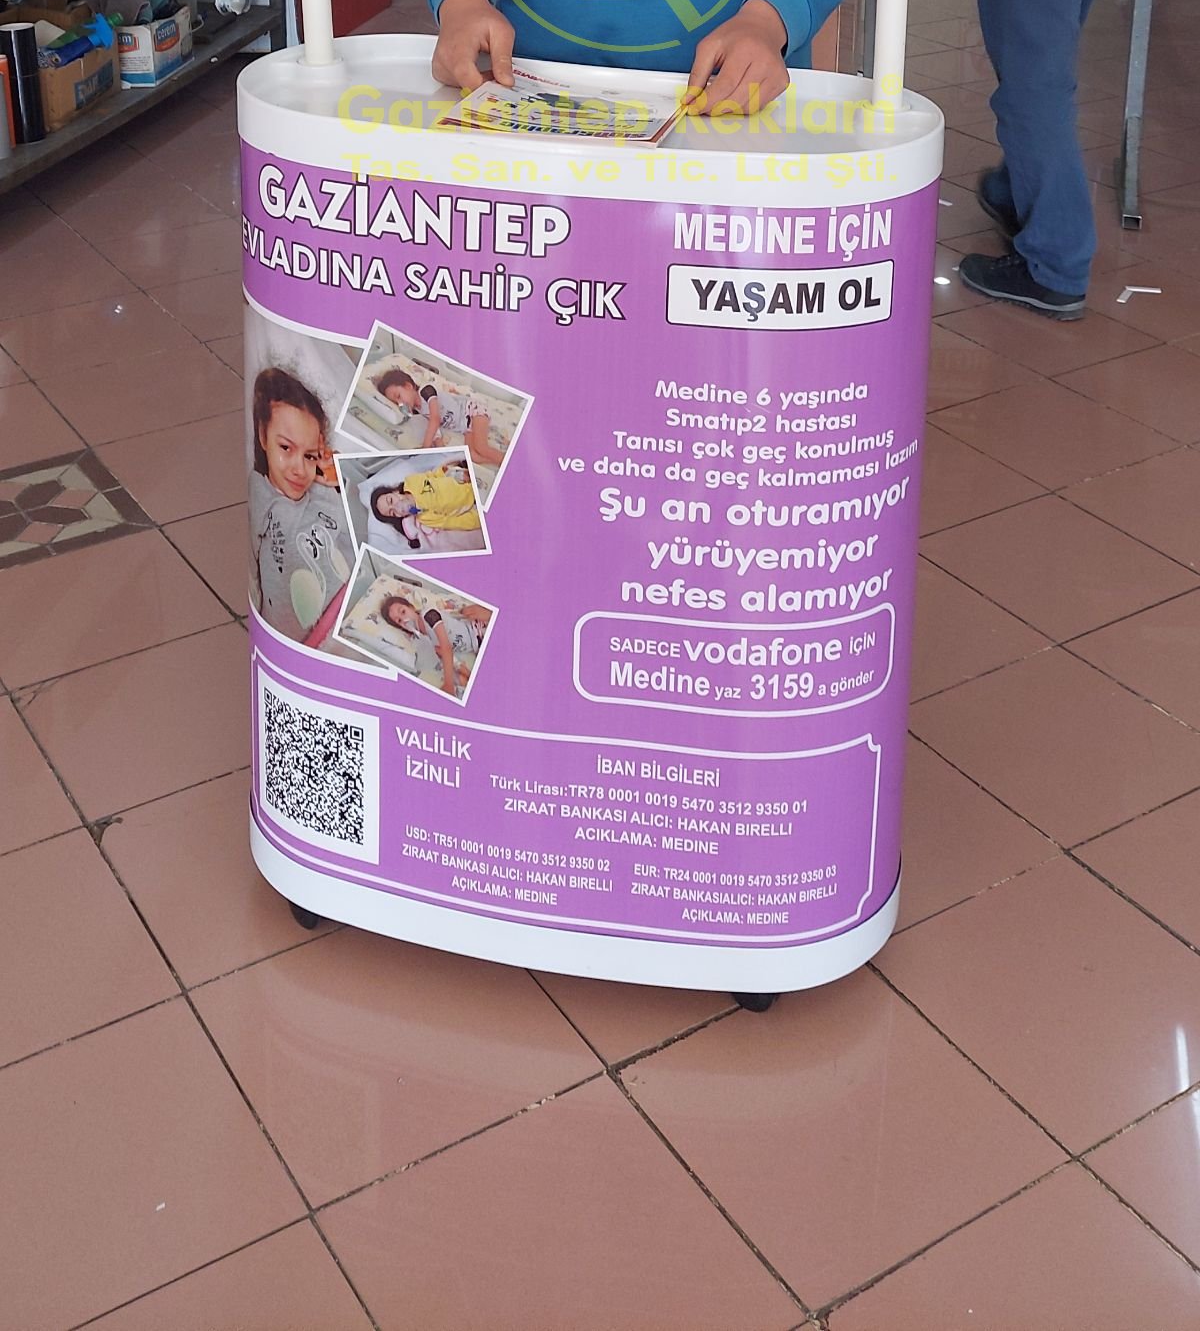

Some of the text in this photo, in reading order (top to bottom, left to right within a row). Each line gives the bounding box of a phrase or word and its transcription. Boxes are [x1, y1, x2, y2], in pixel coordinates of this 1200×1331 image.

[258, 163, 571, 258] GAZİANTEP
[674, 204, 893, 262] MEDİNE İÇİN
[242, 215, 626, 326] EVLADINA SAHİP ÇIK
[691, 277, 881, 322] YAŞAM OL
[655, 380, 868, 410] Medine 6 yaşında
[666, 408, 857, 436] Smatıp2 hastası
[558, 438, 919, 489] ve daha da geç kalmaması lazım
[612, 428, 896, 465] Tanısı çok geç konulmuş
[599, 476, 911, 527] Şu an oturamıyor
[647, 534, 879, 576] yürüyemiyor
[621, 568, 893, 613] nefes alamıyor
[609, 631, 876, 667] SADECE vodafone İÇİN
[610, 660, 875, 701] Medine yaz 3159 a gönder
[396, 726, 472, 761] VALİLİK
[406, 755, 461, 789] İZİNLİ
[597, 754, 721, 788] İBAN BİLGİLERİ
[490, 774, 521, 791] Türk
[608, 788, 640, 803] 0001
[645, 791, 678, 808] 0019
[682, 796, 715, 813] 5470
[719, 800, 752, 816] 3512
[756, 801, 789, 816] 9350
[792, 799, 808, 814] 01
[504, 797, 793, 837] ZIRAAT BANKASI ALICI: HAKAN BIRELLI
[405, 824, 610, 872] USD: TR51 0001 0019 5470 3512 9350 02
[574, 827, 720, 855] ACIKLAMA: MEDINE
[402, 843, 613, 893] ZIRAAT BANKASI ALICI: HAKAN BIRELLI
[634, 863, 837, 887] EUR: TR24 0001 0019 5470 3512 9350 03
[451, 876, 558, 906] AÇIKLAMA: MEDINE
[631, 882, 671, 898] ZIRAAT
[757, 892, 797, 906] HAKAN
[799, 882, 838, 904] BIRELLI
[681, 908, 789, 926] AÇIKLAMA: MEDINE
